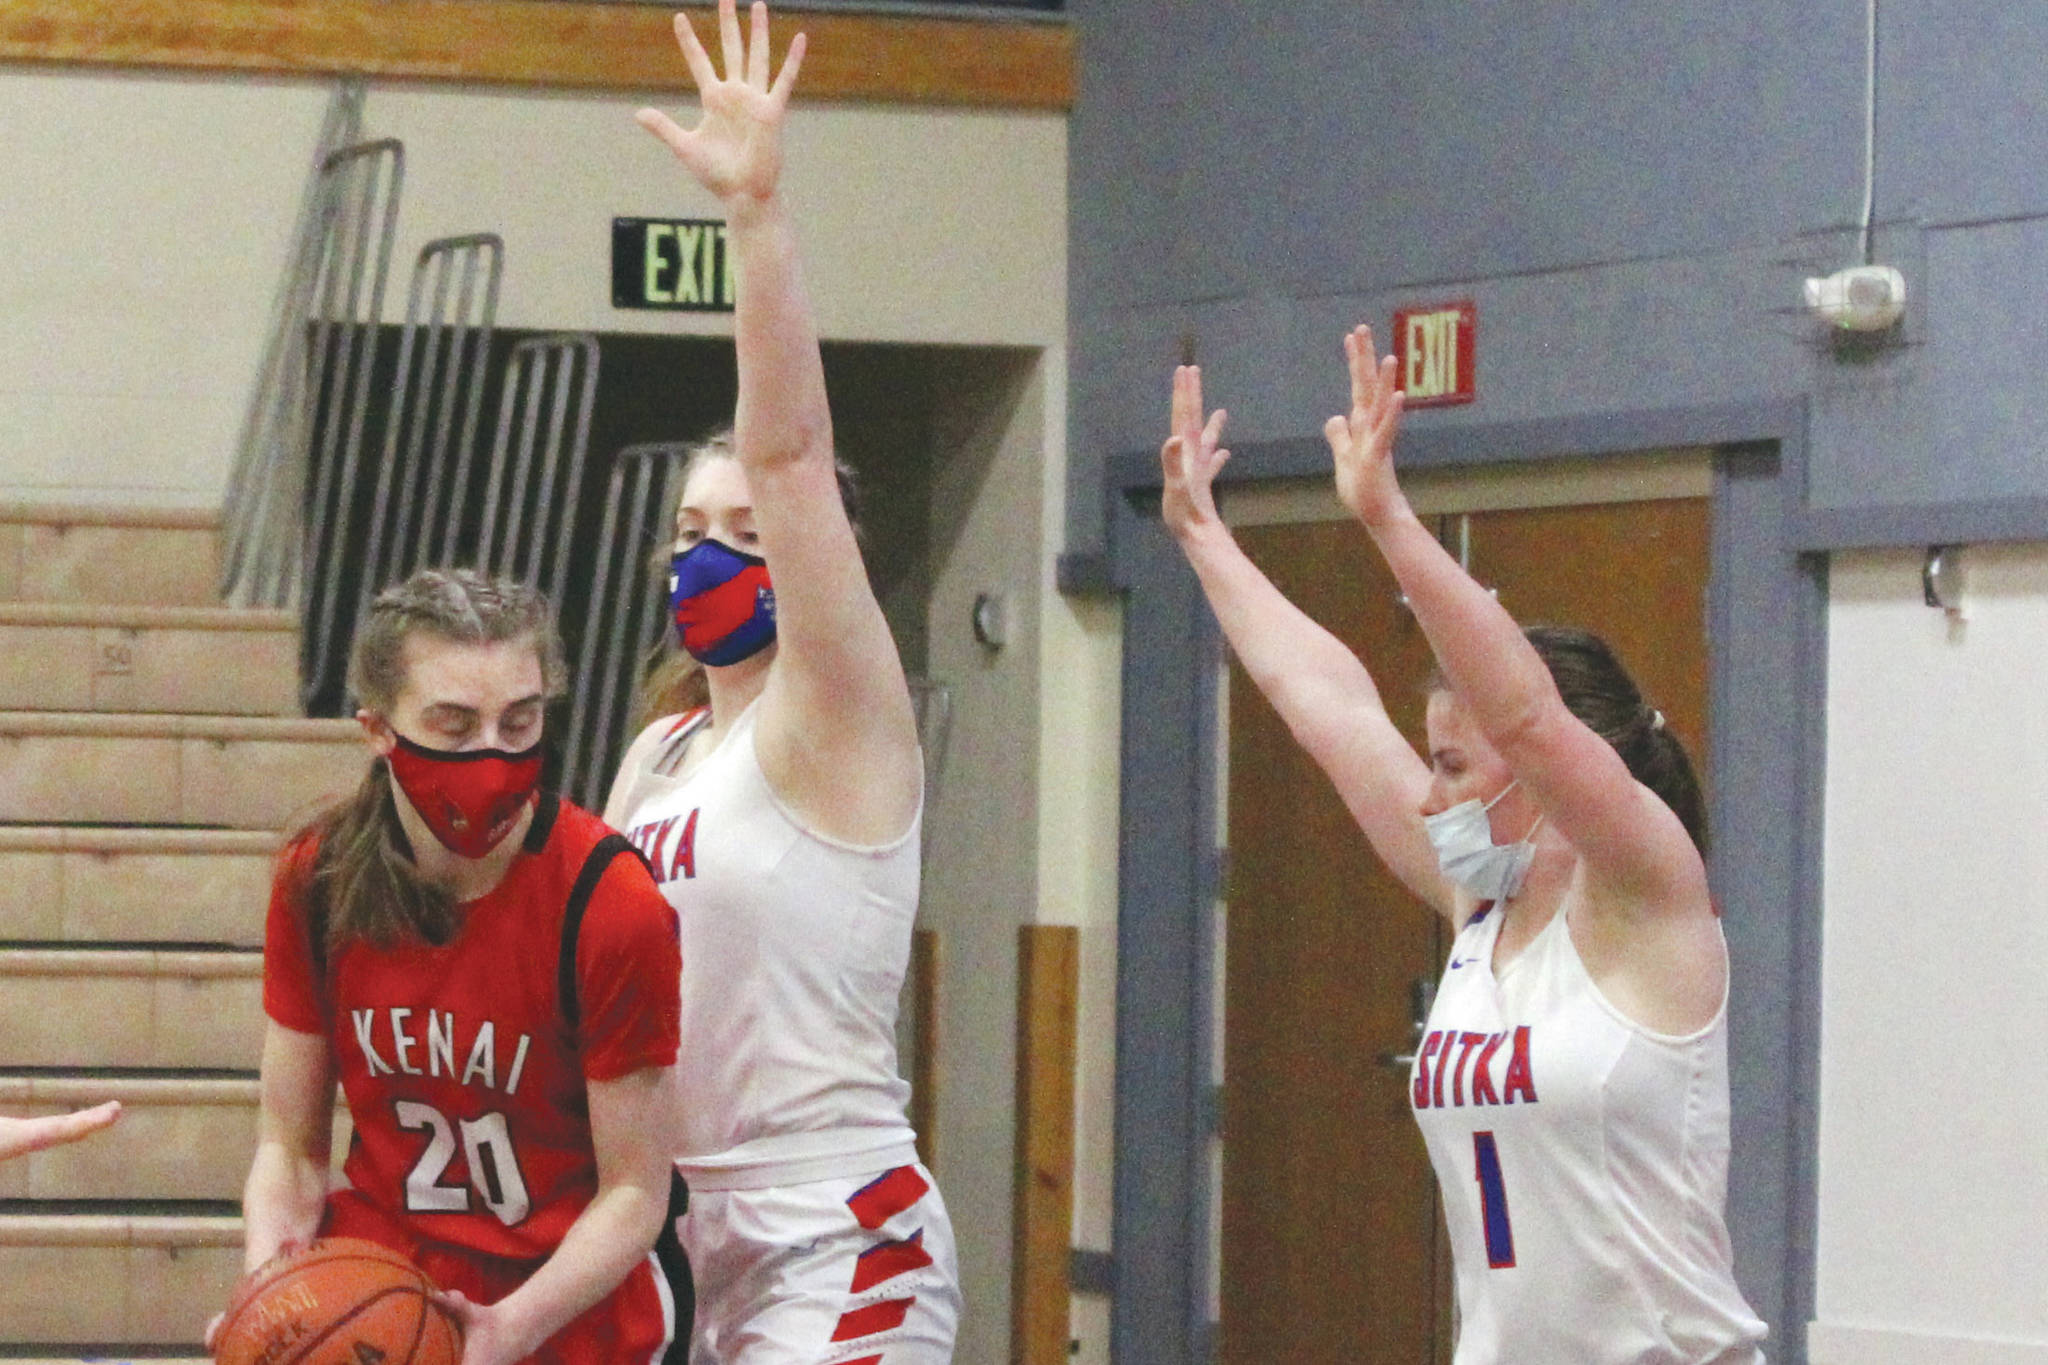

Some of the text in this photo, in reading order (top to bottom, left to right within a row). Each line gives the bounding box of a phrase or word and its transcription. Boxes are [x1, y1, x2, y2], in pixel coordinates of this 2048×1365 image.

[1406, 310, 1460, 397] EXIT
[351, 1007, 531, 1095] KENAI
[1413, 1025, 1539, 1109] SITKA
[396, 1101, 530, 1226] 20
[1472, 1130, 1516, 1269] 1
